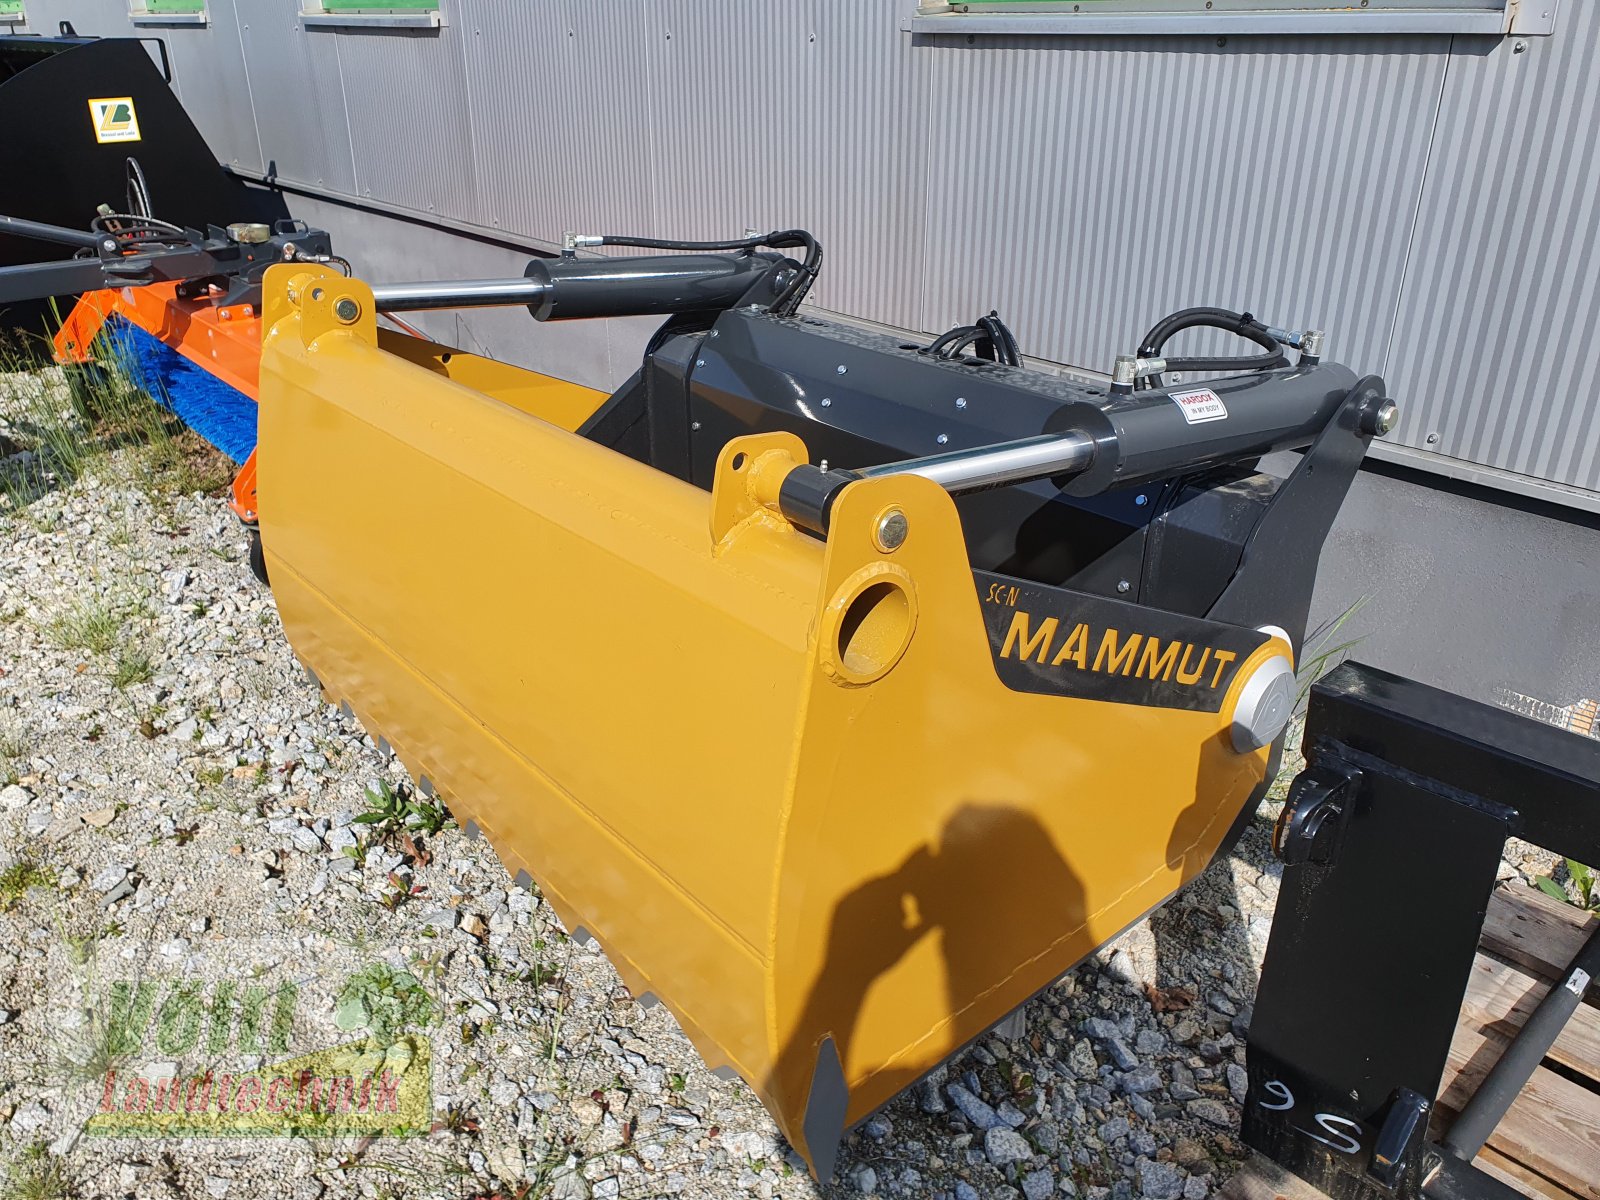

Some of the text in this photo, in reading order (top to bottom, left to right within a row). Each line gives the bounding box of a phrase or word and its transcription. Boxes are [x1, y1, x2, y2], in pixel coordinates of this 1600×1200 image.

[1180, 393, 1214, 406] HARDOX
[1190, 404, 1220, 415] IN MY BODY
[1000, 610, 1237, 689] MAMMUT
